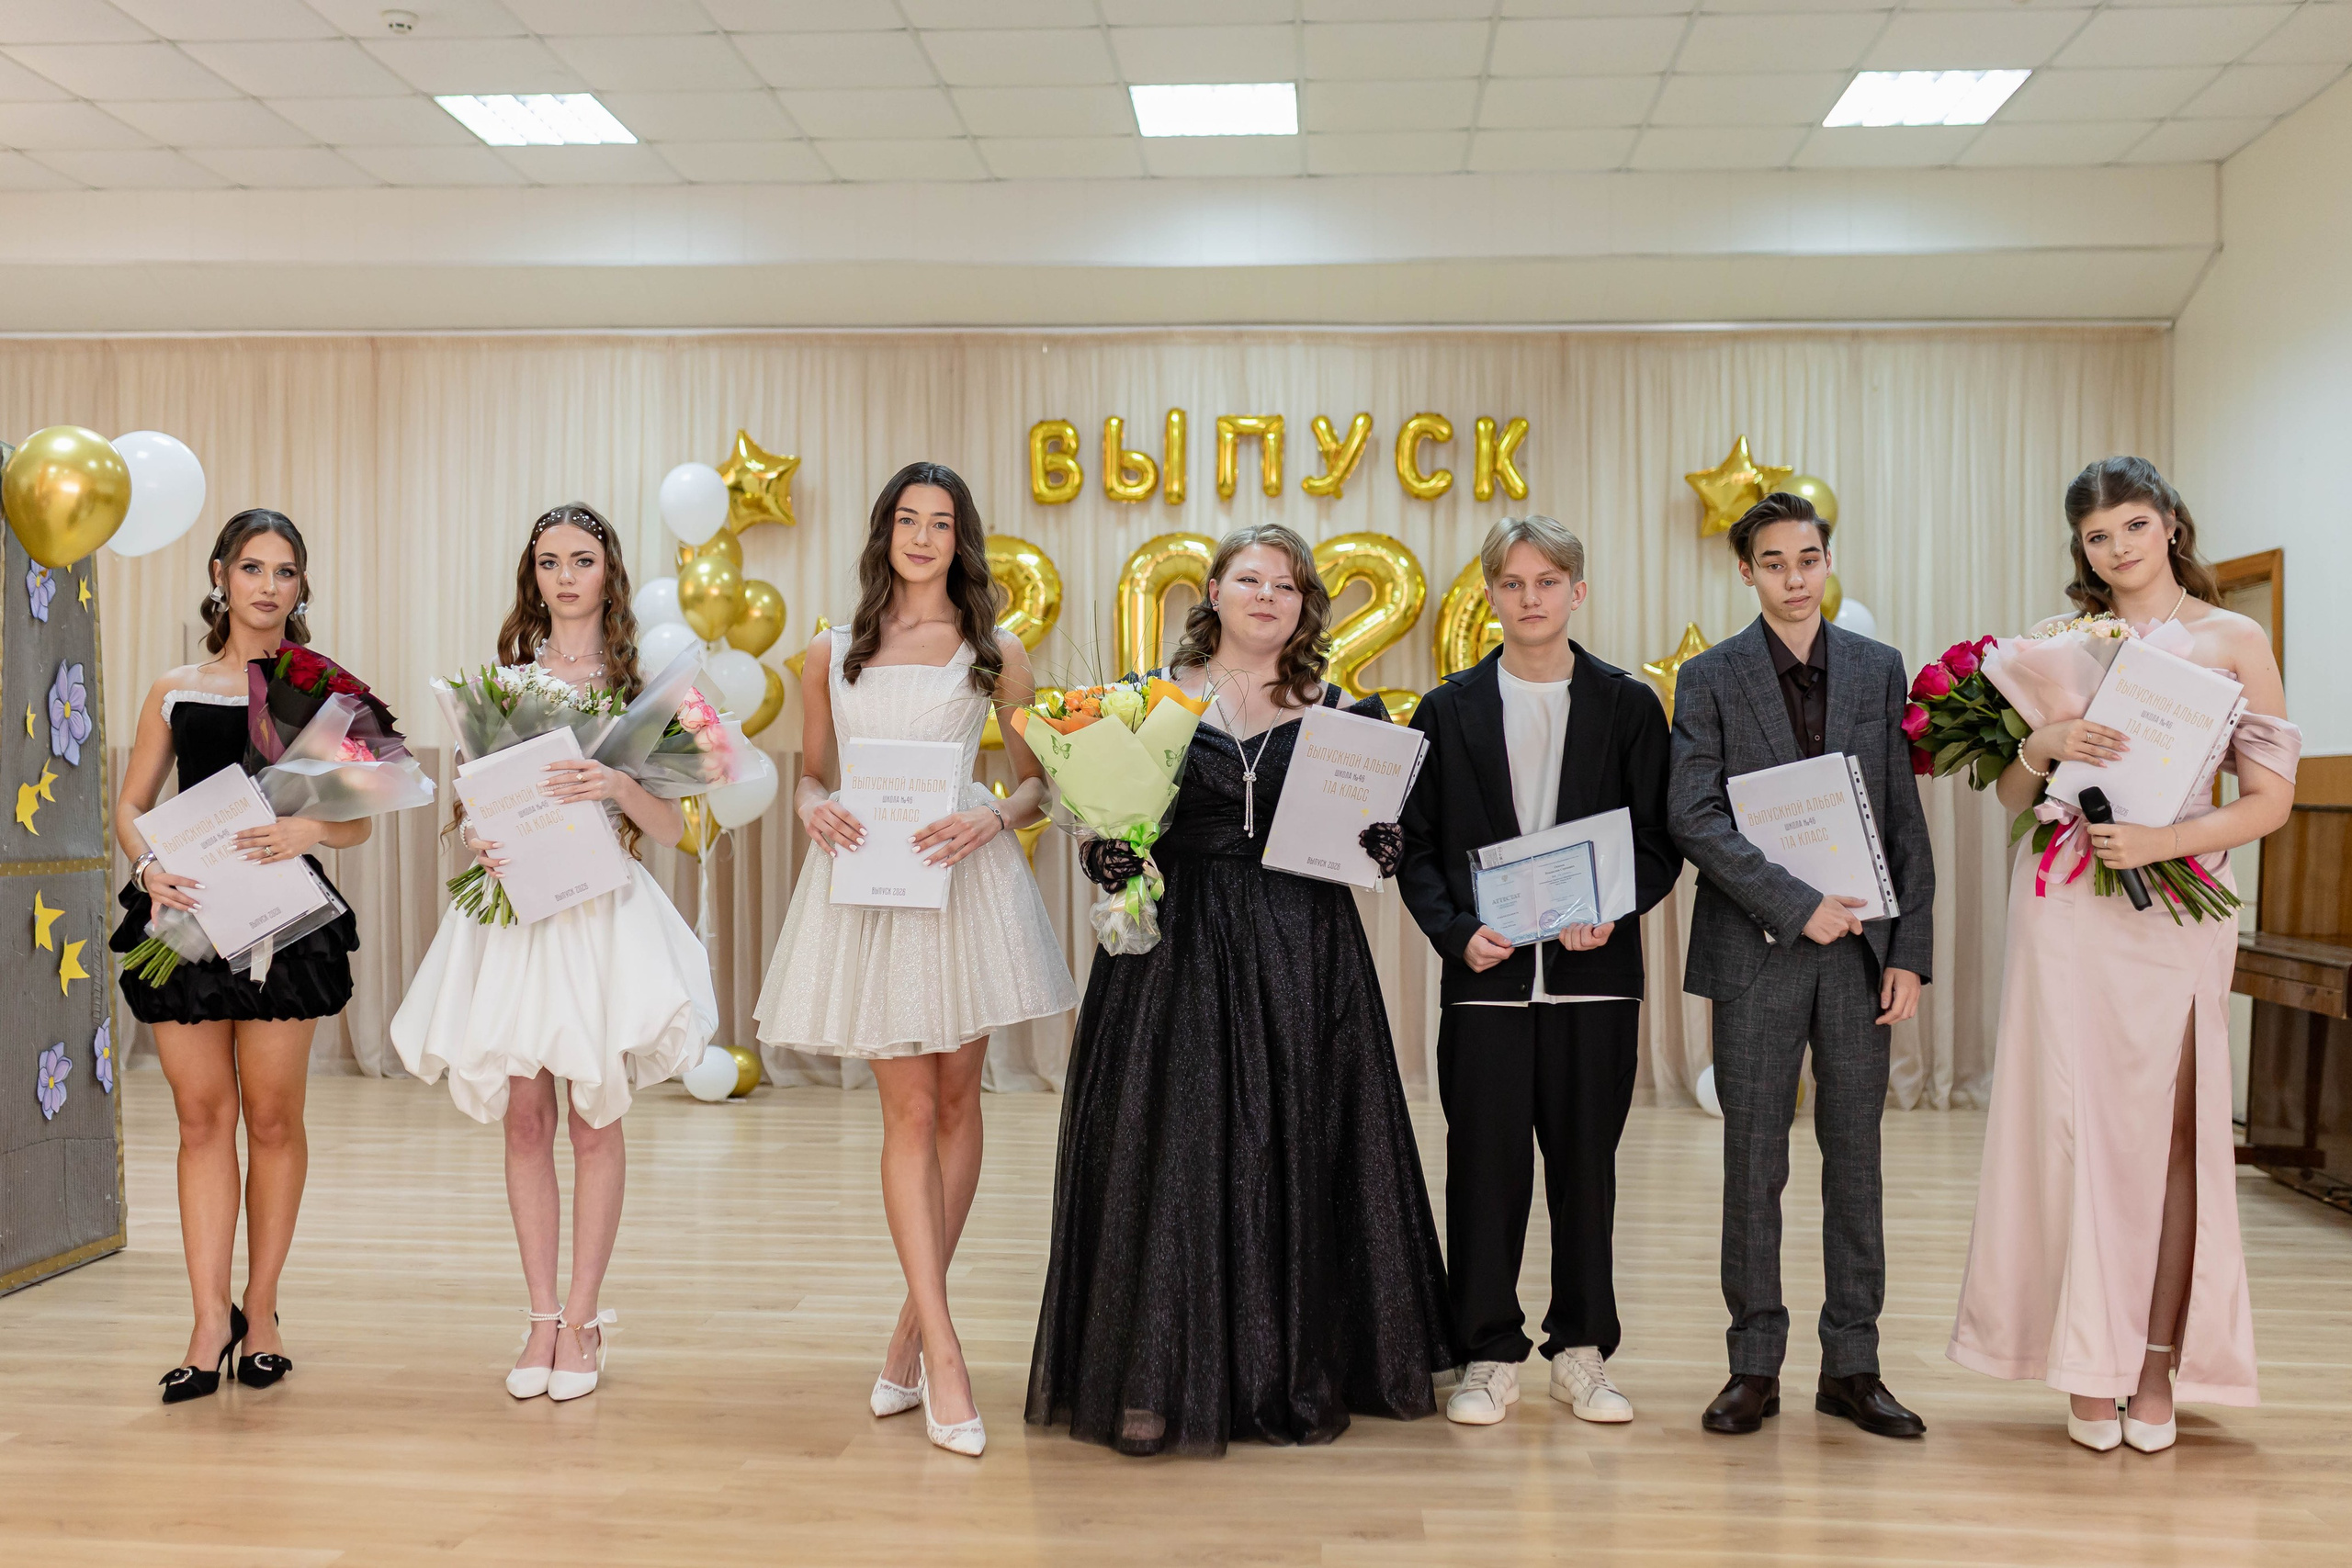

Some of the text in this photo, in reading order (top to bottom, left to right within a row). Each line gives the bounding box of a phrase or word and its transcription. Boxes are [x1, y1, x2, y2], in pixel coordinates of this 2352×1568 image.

[1030, 407, 1530, 505] ВЫПУСК
[2115, 678, 2215, 731] ВЫПУСКНОЙ АЛЬБОМ
[2140, 709, 2160, 724] ШКОЛА
[2124, 718, 2175, 750] 11А КЛАСС
[1306, 744, 1402, 777] ВЫПУСКНОЙ АЛЬБОМ
[852, 776, 946, 793] ВЫПУСКНОЙ АЛЬБОМ
[1334, 769, 1352, 781] ШКОЛА
[882, 795, 899, 804] ШКОЛА
[1322, 780, 1370, 802] 11А КЛАСС
[480, 787, 534, 818] ВЫПУСКНОЙ
[517, 806, 537, 818] ШКОЛА
[1747, 791, 1846, 827] ВЫПУСКНОЙ АЛЬБОМ
[162, 796, 251, 854] ВЫПУСКНОЙ АЛЬБОМ
[516, 808, 565, 837] 11А КЛАСС
[874, 807, 920, 823] 11А КЛАСС
[1783, 821, 1803, 831] ШКОЛА
[1780, 827, 1829, 851] 11А КЛАСС
[200, 852, 219, 869] 11А
[1306, 857, 1327, 869] ВЫПУСК
